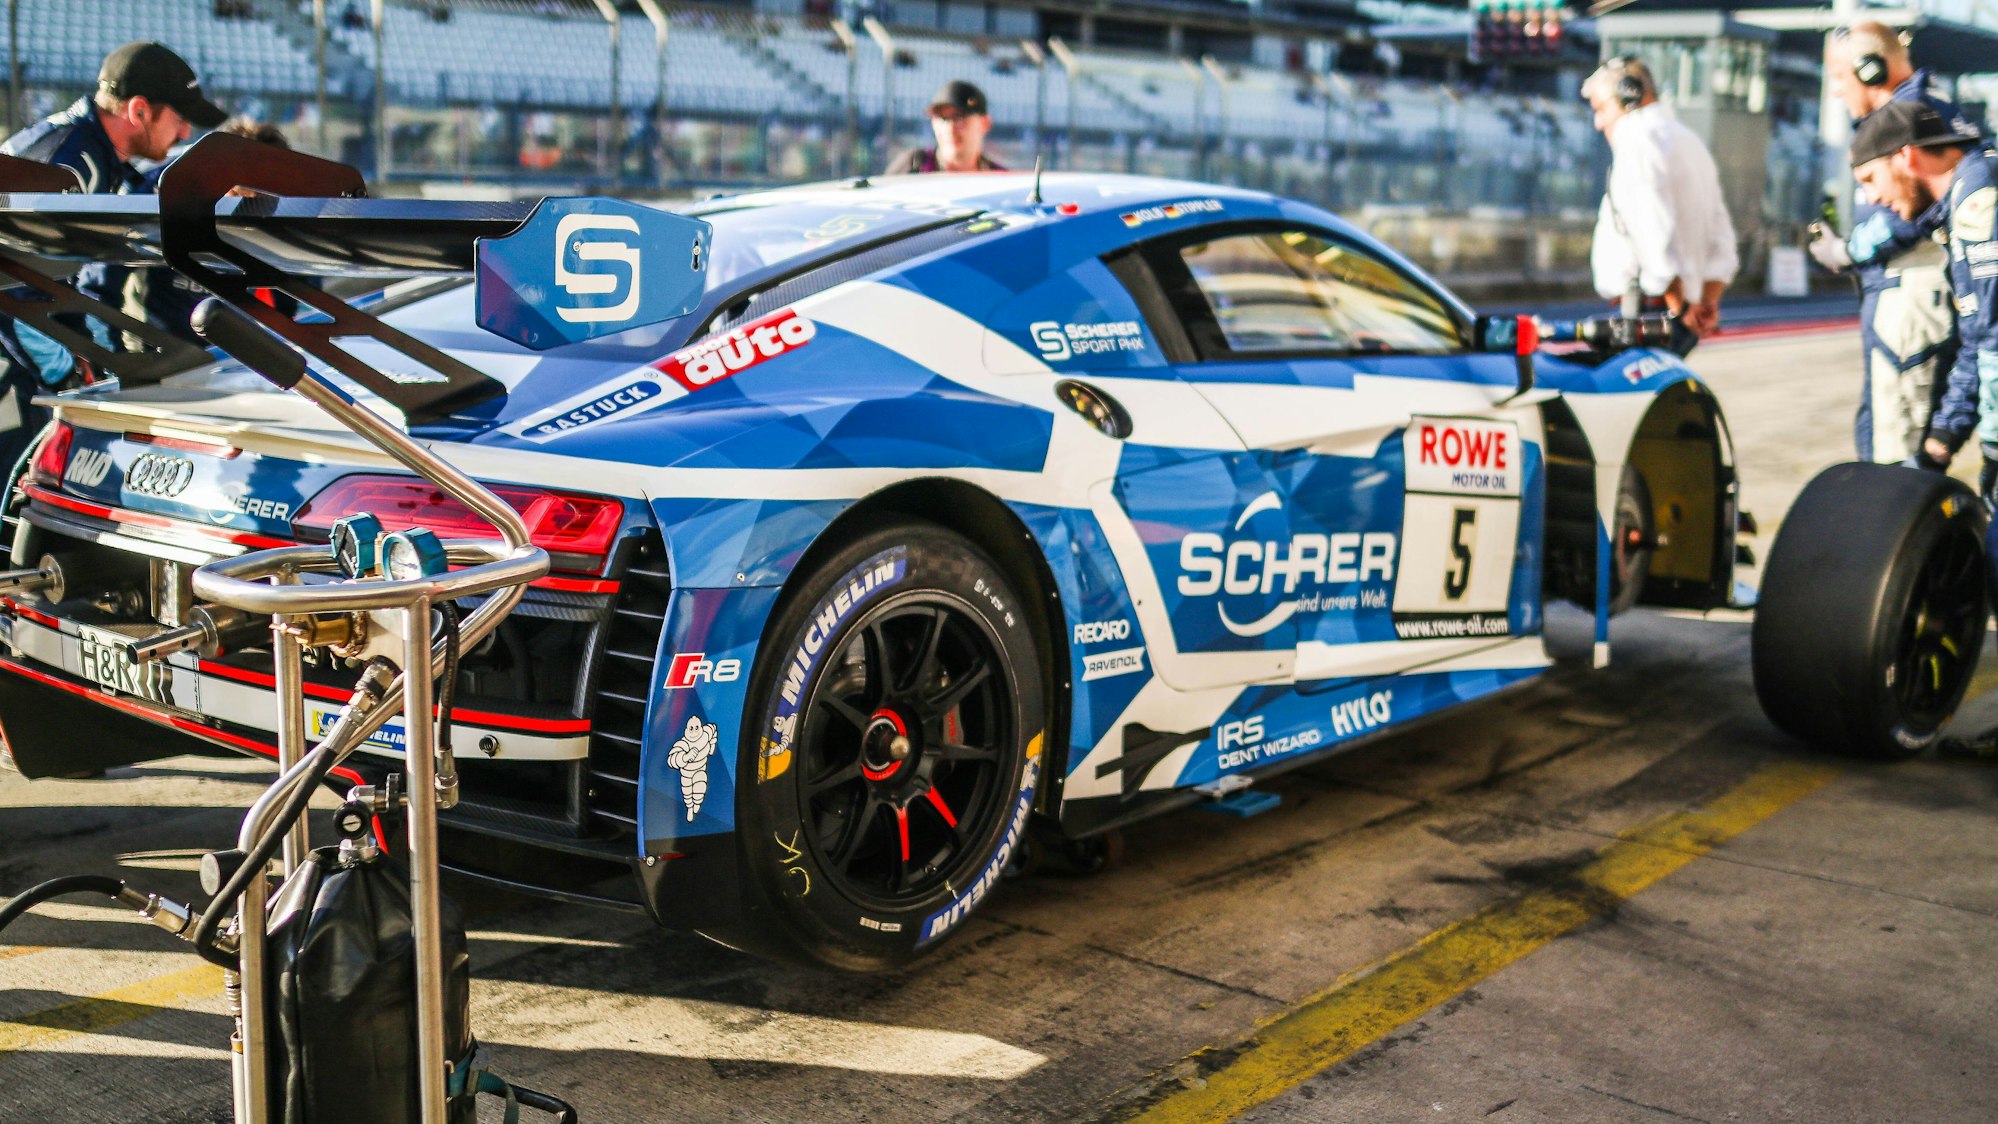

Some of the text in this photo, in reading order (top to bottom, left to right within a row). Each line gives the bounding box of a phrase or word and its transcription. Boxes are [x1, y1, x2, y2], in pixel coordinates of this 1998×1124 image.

[684, 314, 817, 386] auto
[1064, 321, 1141, 340] SCHERER
[1070, 336, 1145, 355] SPORT PHX
[537, 384, 650, 435] BASTUCK
[65, 446, 113, 487] RWD
[1419, 424, 1508, 470] ROWE
[1452, 472, 1507, 490] MOTOR OIL
[1443, 507, 1477, 601] 5
[780, 560, 896, 706] MICHELIN
[1073, 618, 1130, 645] RECARO
[1395, 614, 1509, 641] www.rowe-oil.com
[77, 626, 135, 695] H&R
[682, 659, 741, 685] R8
[1088, 655, 1137, 673] RAVENOL
[369, 730, 405, 745] ELIN
[1216, 714, 1264, 752] IRS
[1217, 728, 1323, 770] DENT WIZARD
[928, 797, 1029, 939] MICHELIN
